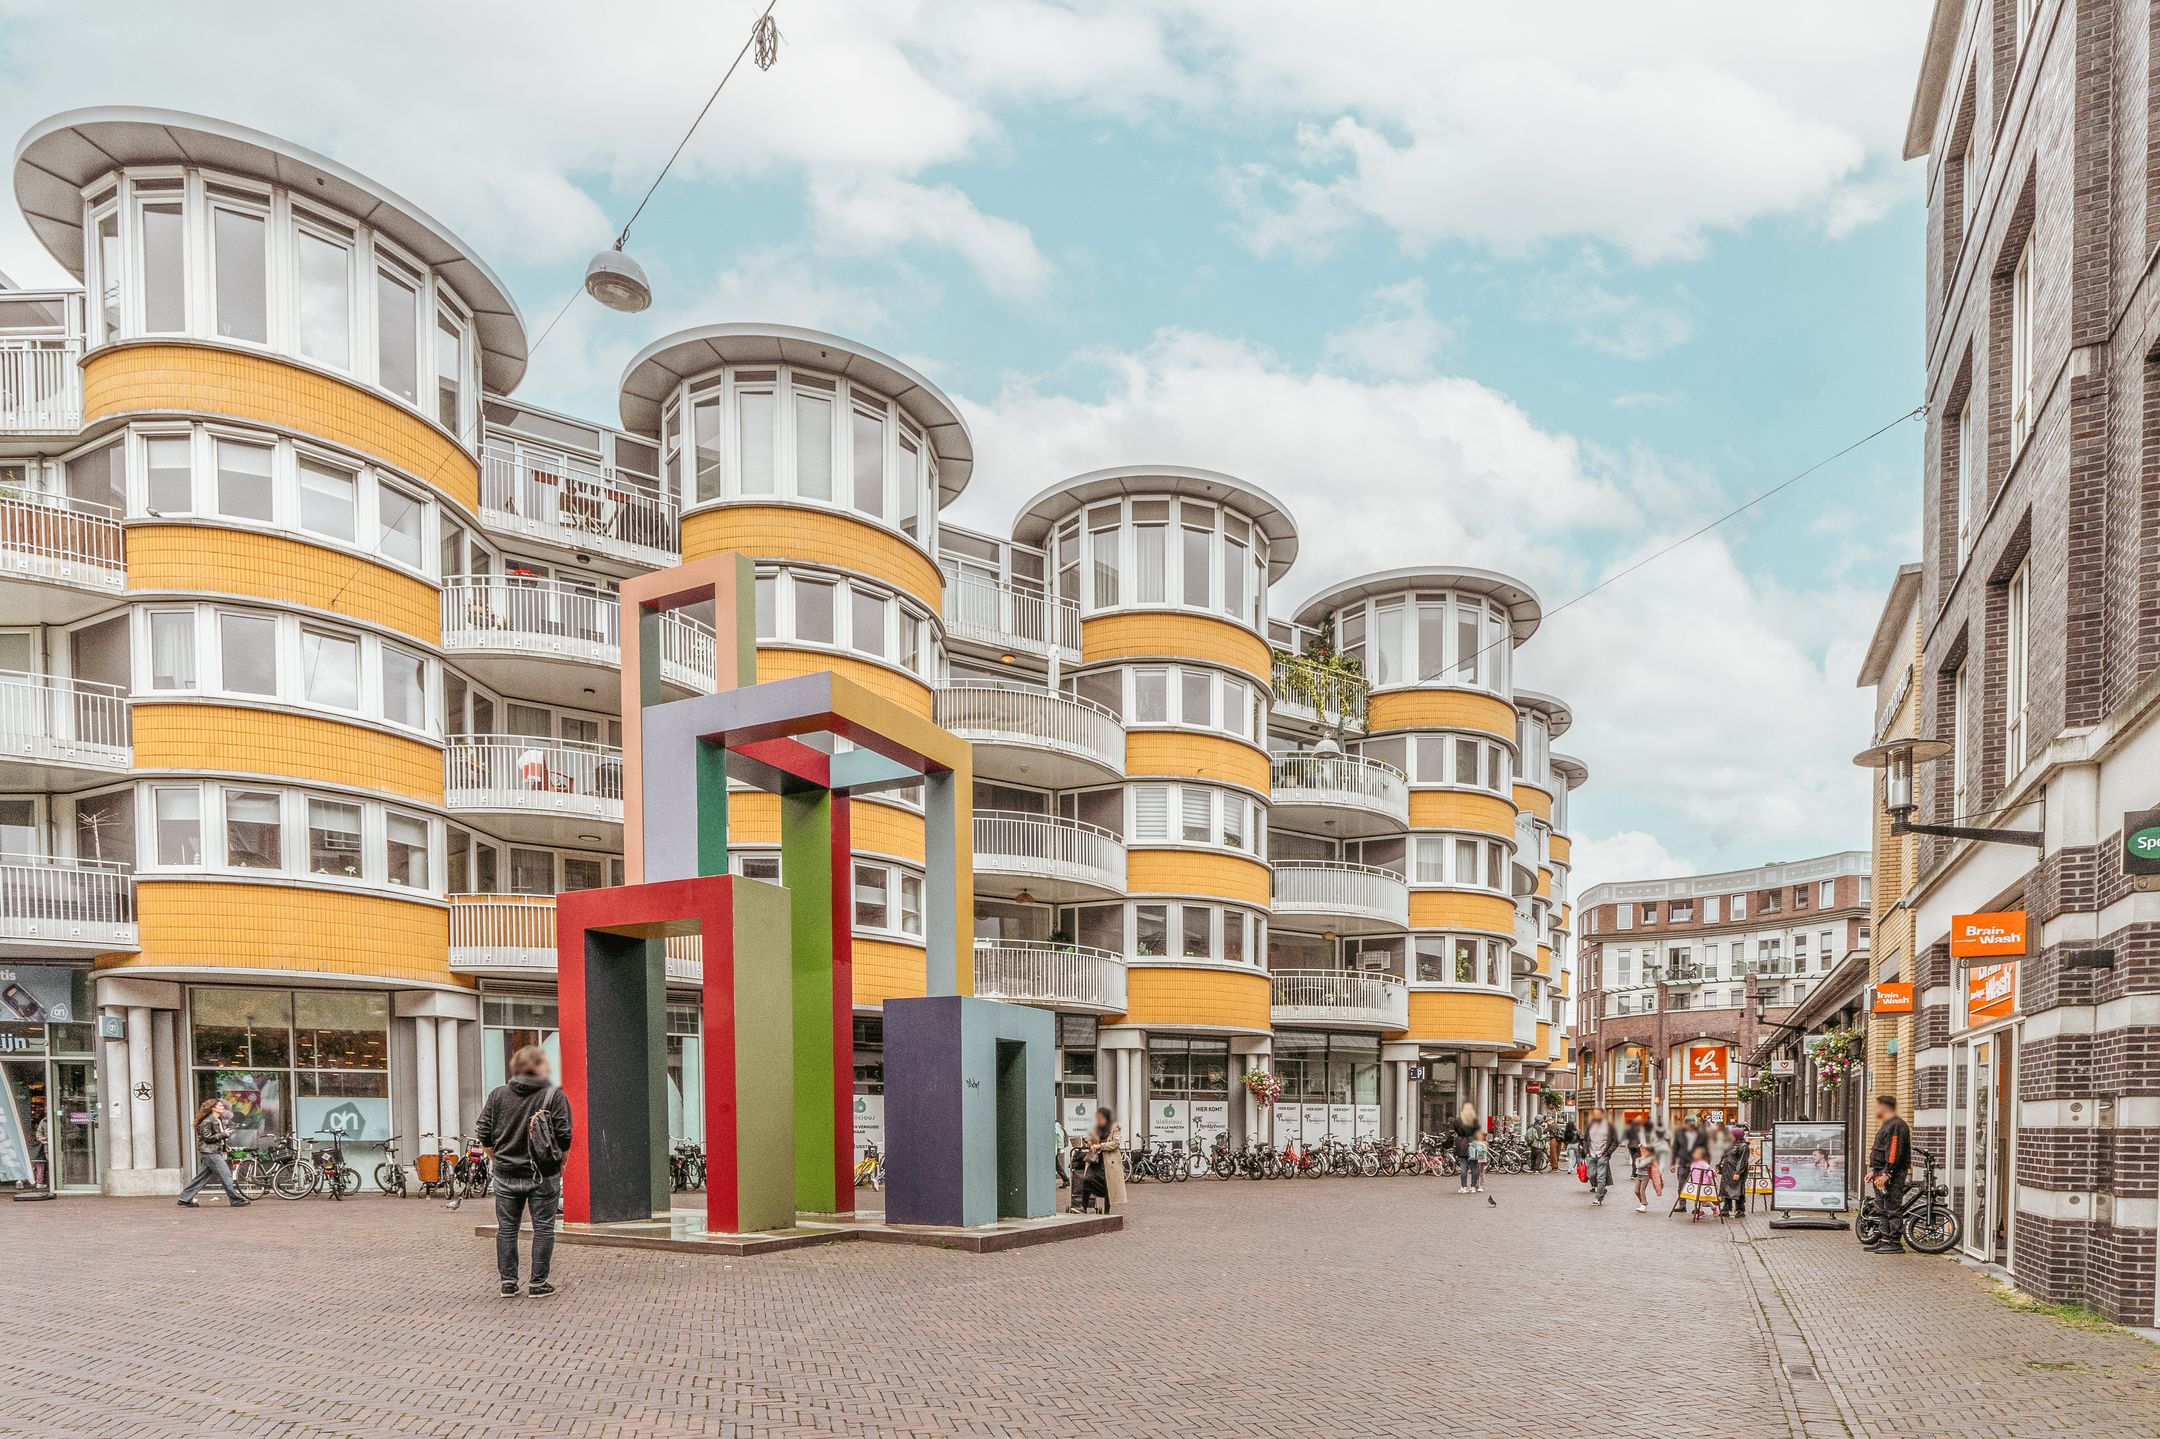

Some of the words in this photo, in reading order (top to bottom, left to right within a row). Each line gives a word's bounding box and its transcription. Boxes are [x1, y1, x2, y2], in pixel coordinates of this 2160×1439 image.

[1966, 925, 2005, 937] Brain
[1979, 932, 2021, 945] Wash
[1882, 997, 1910, 1005] Wash
